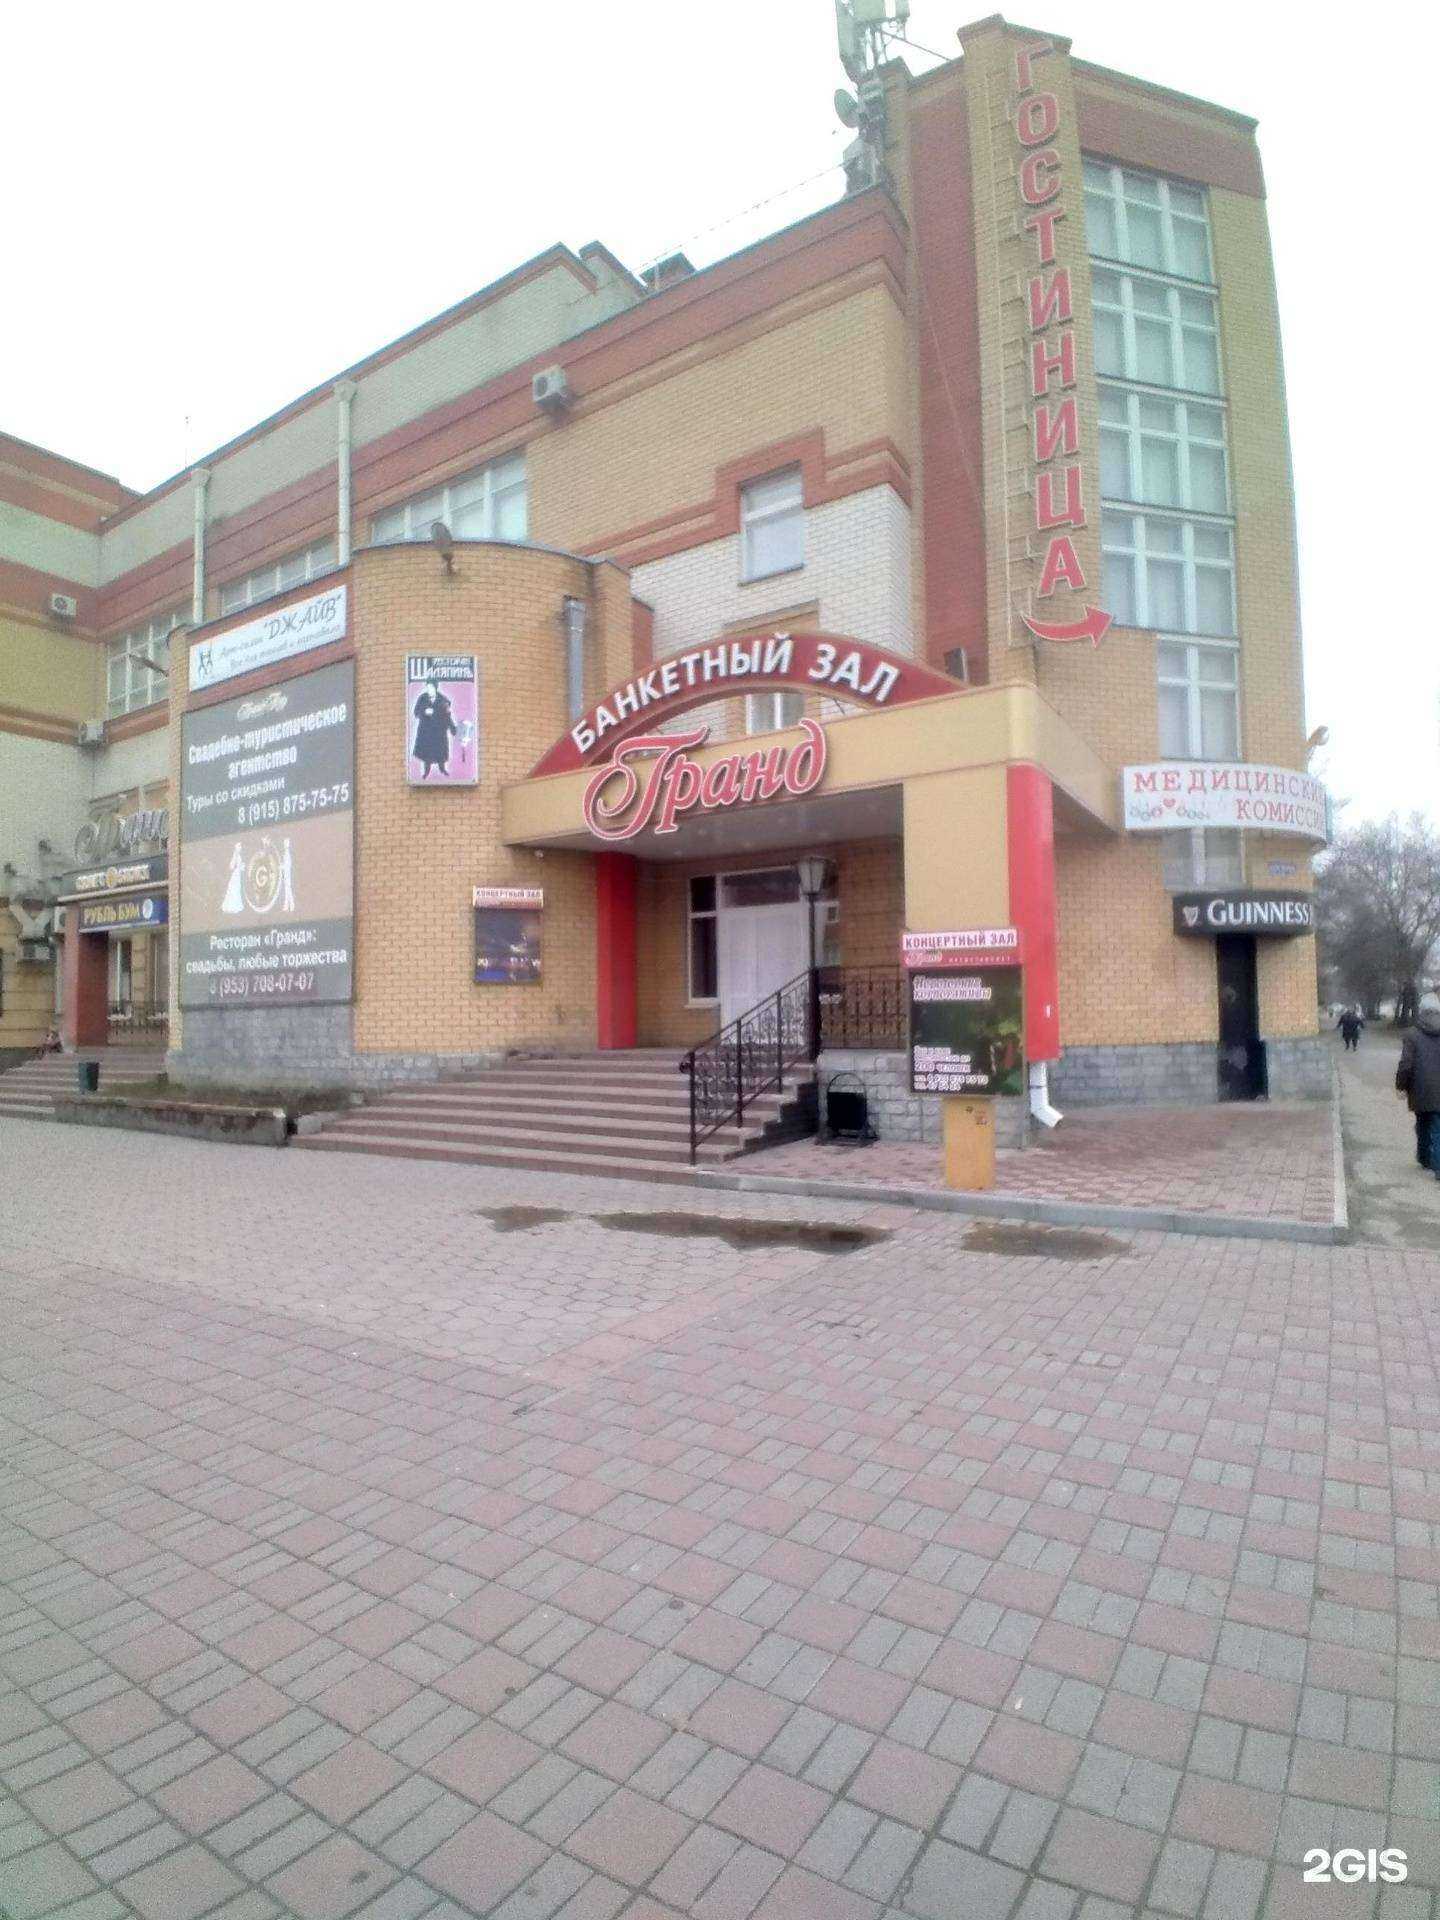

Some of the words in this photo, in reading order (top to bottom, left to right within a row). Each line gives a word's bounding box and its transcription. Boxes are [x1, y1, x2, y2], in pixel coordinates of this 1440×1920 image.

[1016, 39, 1087, 598] ГОСТИНИЦА
[571, 632, 794, 754] БАНКЕТНЫЙ
[808, 643, 900, 702] ЗАЛ
[228, 746, 298, 780] агентство
[582, 718, 827, 841] Гранд
[187, 795, 213, 813] Туры
[216, 790, 229, 804] со
[231, 777, 285, 800] скидками
[238, 807, 246, 824] 8
[249, 800, 280, 826] (915)
[283, 783, 349, 815] 875-75-75
[1207, 899, 1312, 926] GUINNESS
[210, 935, 261, 951] Ресторан
[905, 931, 986, 949] КОНЦЕРТНЫЙ
[991, 931, 1015, 946] ЗАЛ
[282, 949, 348, 968] торжества
